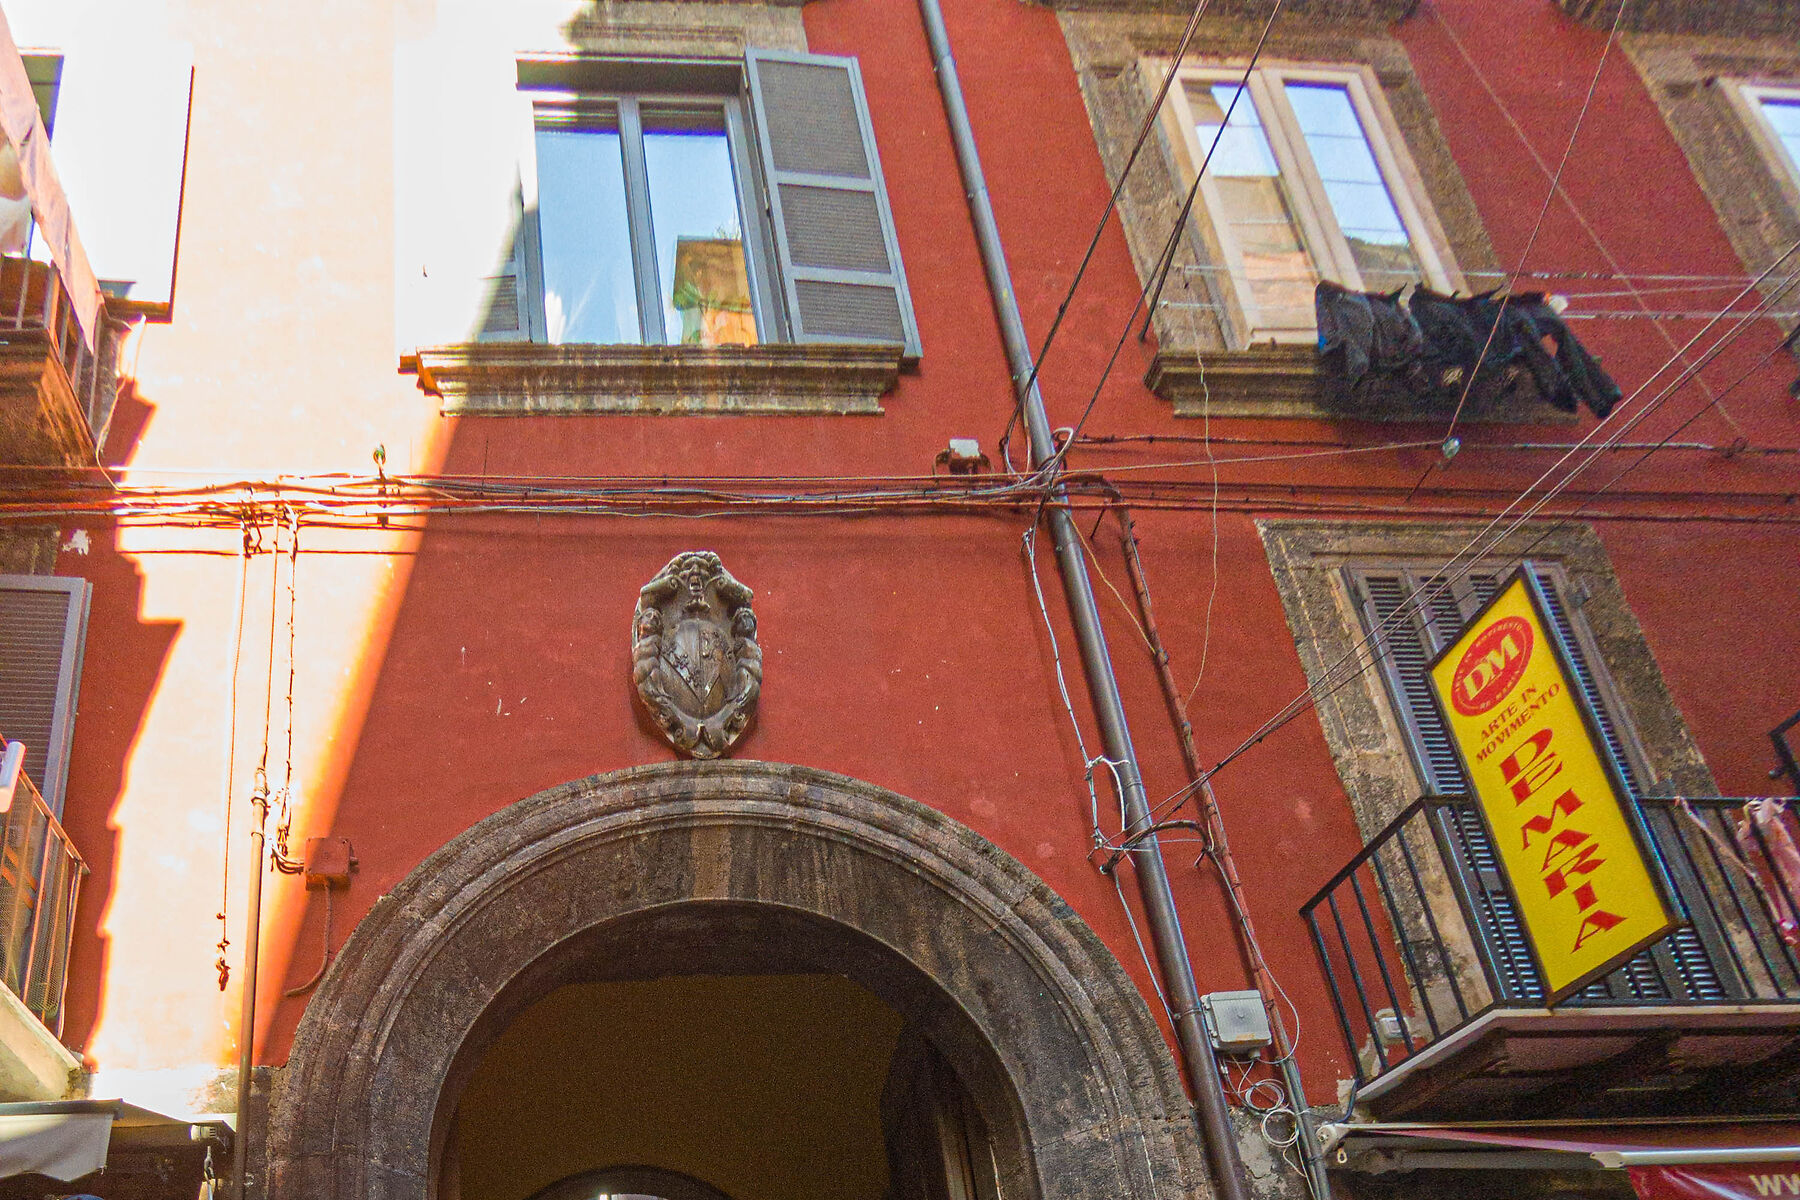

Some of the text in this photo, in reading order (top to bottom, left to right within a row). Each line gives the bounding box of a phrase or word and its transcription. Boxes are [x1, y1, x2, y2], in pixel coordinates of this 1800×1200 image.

[1463, 634, 1520, 700] DM
[1476, 683, 1560, 762] MOVIMENTO
[1481, 683, 1537, 741] ARTE IN
[1500, 728, 1628, 954] DE MARIA
